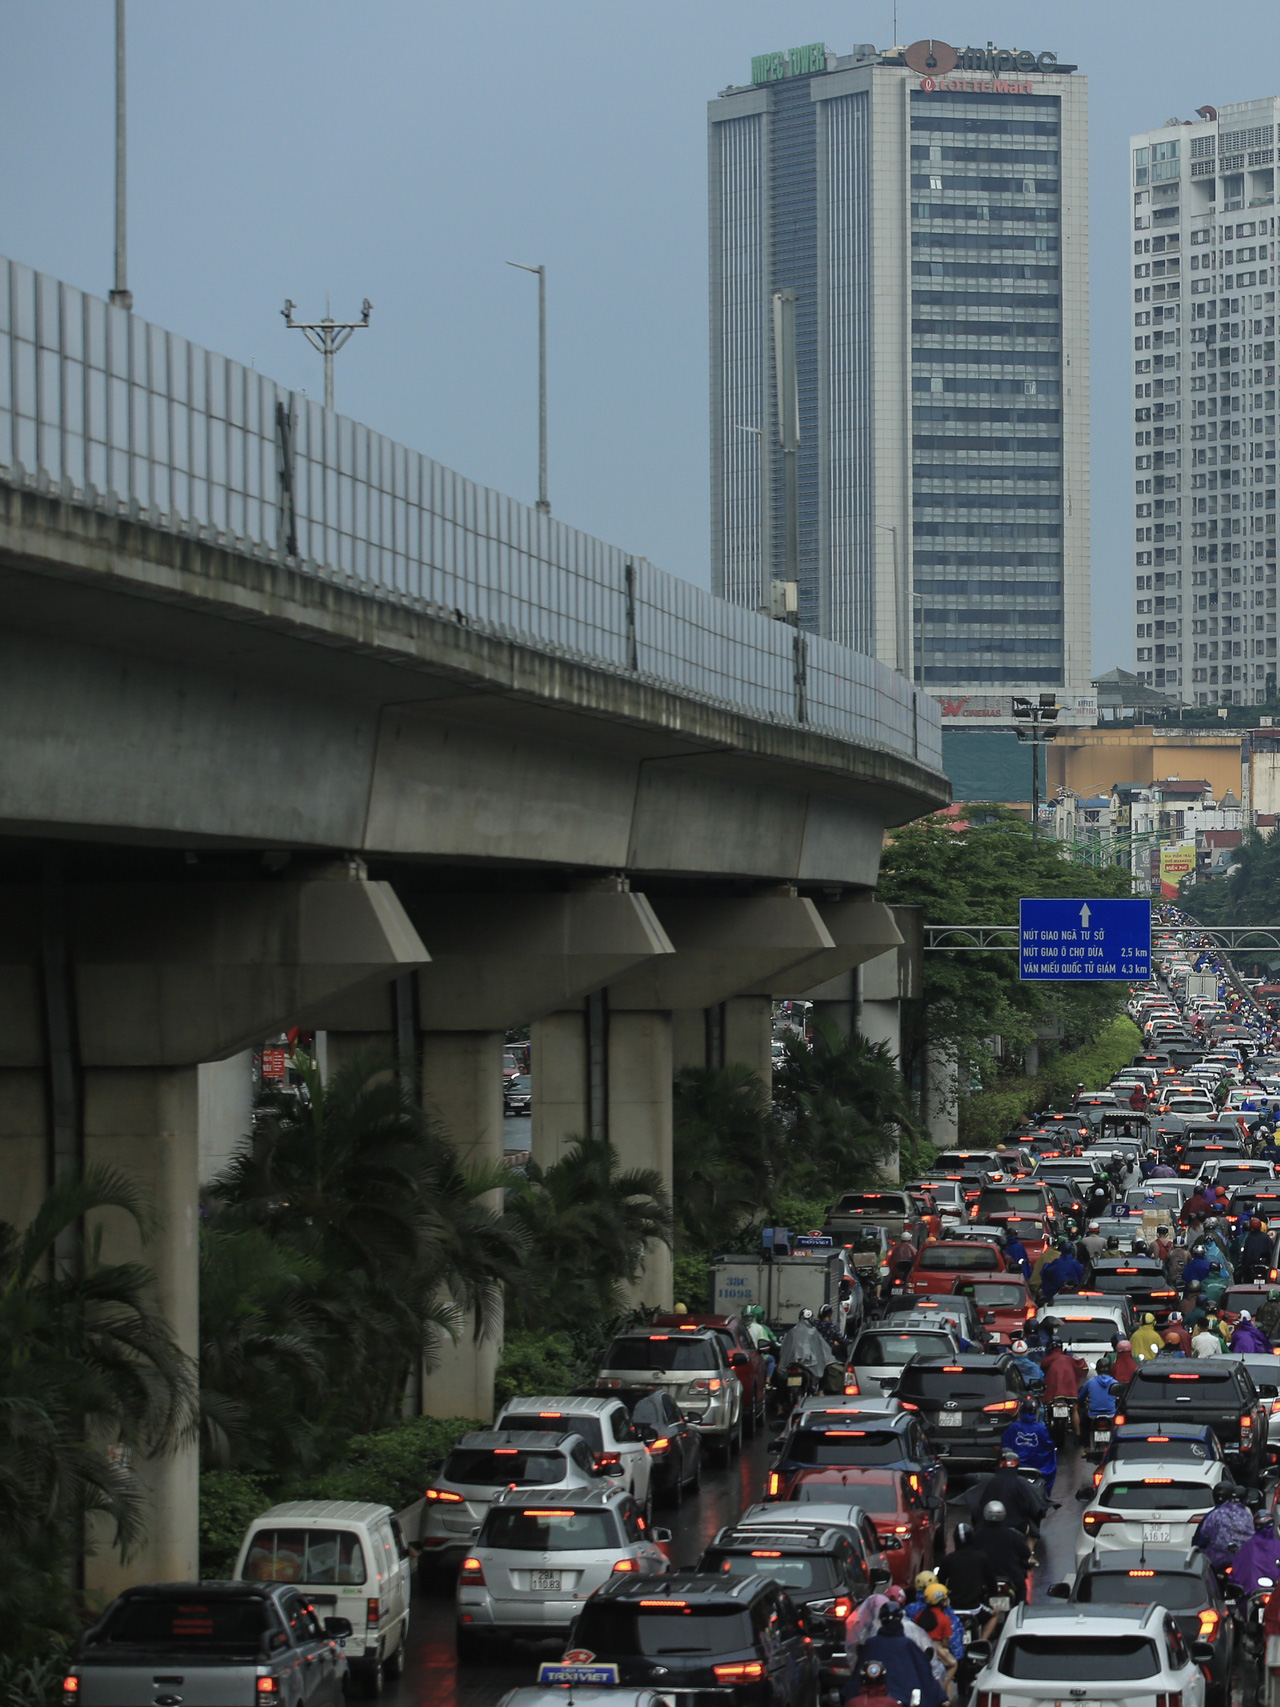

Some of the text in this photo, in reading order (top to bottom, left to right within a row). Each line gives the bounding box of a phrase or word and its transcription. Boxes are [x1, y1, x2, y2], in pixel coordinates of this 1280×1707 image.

[751, 42, 825, 84] MIPEC TOWER
[963, 41, 1058, 79] mipec
[940, 80, 1033, 94] LOTTE Mart
[1023, 928, 1105, 940] NÚT GIAO NGÃ TƯ SỞ
[1023, 945, 1038, 957] NÚT
[1040, 947, 1058, 957] GIAO
[1061, 946, 1066, 957] Ô
[1069, 947, 1085, 958] CHỢ
[1088, 946, 1104, 957] DỪA
[1135, 948, 1147, 957] km
[1024, 963, 1038, 973] VĂN
[1041, 961, 1059, 973] MIẾU
[1062, 961, 1082, 974] QUỐC
[1084, 961, 1094, 973] TỬ
[1097, 962, 1116, 973] GIÁM
[1135, 964, 1147, 973] km
[1115, 1206, 1125, 1216] G7
[719, 1289, 752, 1298] 11098
[533, 1580, 560, 1589] 110.83
